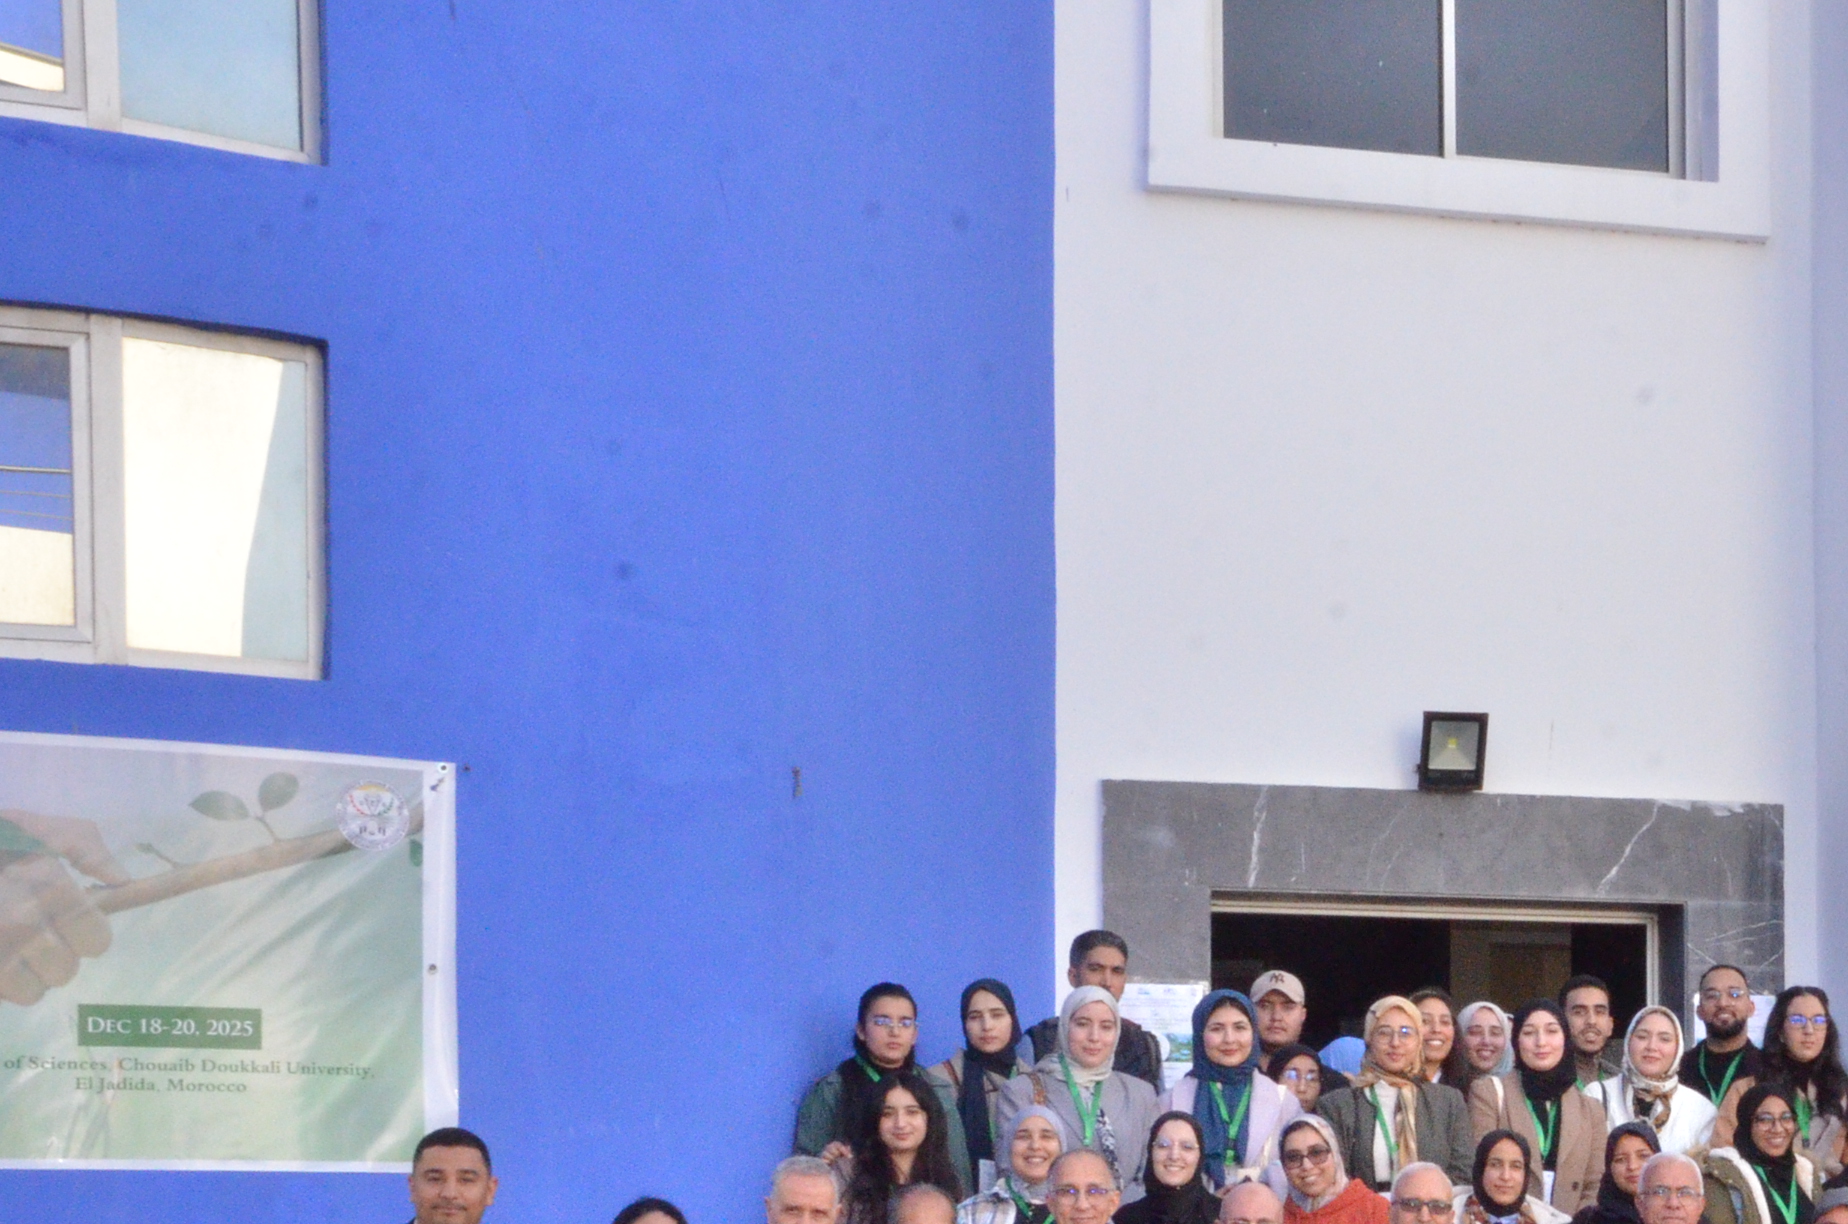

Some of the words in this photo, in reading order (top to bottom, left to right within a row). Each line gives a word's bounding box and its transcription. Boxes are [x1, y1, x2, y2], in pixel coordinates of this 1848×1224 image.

[206, 1019, 254, 1037] 2025
[3, 1055, 25, 1070] of
[118, 1056, 196, 1073] Chouaib
[201, 1058, 281, 1075] Doukkali
[74, 1076, 94, 1091] El
[167, 1078, 248, 1094] Morocco
